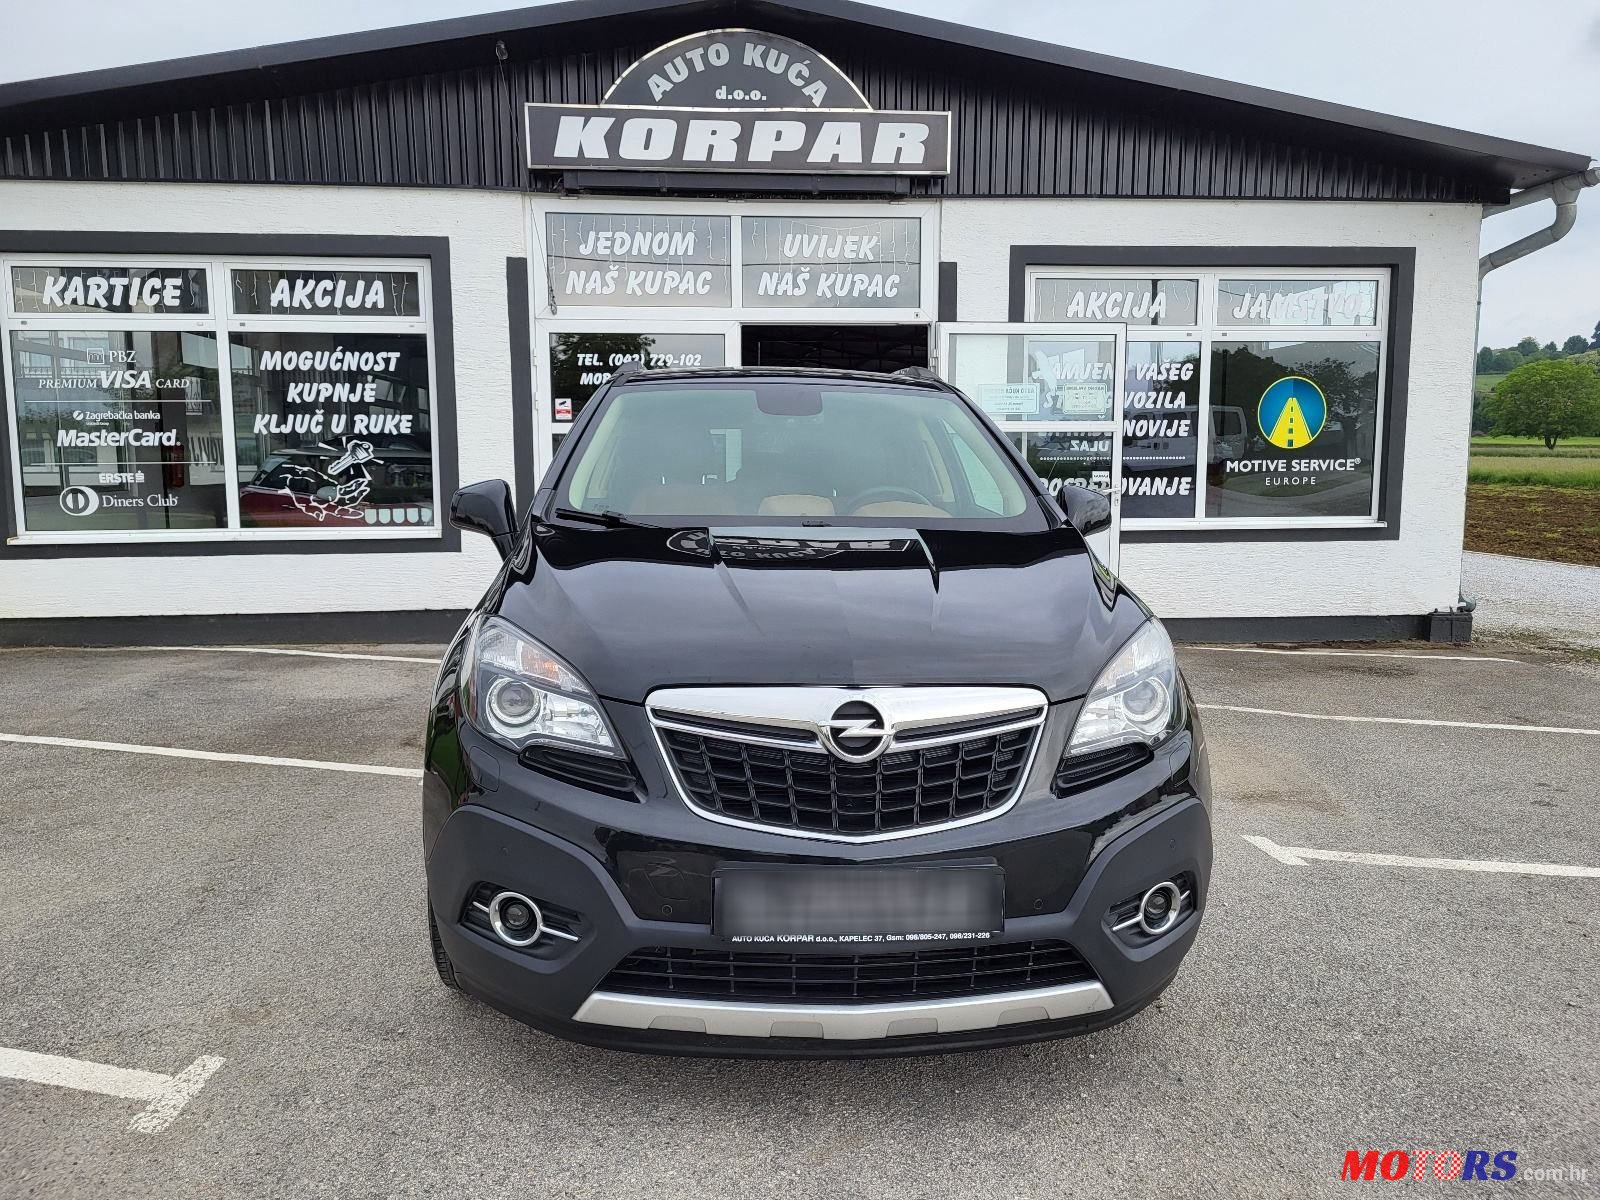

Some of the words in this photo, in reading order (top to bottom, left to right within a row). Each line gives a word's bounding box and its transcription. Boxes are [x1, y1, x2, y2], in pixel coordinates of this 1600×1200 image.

[646, 42, 730, 102] AUTO
[743, 42, 829, 107] KUĆA
[715, 86, 767, 101] d.o.o.
[553, 116, 930, 164] KORPAR
[579, 231, 696, 257] JEDNOM
[783, 233, 878, 262] UVIJEK
[565, 265, 619, 296] NAŠ
[625, 270, 713, 296] KUPAC
[758, 267, 812, 298] NAŠ
[816, 272, 900, 299] KUPAC
[43, 276, 182, 308] KARTICE
[270, 278, 385, 309] AKCIJA
[1066, 291, 1167, 319] AKCIJA
[109, 350, 136, 362] PBZ
[260, 346, 400, 372] MOGUĆNOST
[577, 354, 603, 366] TEL.
[649, 354, 702, 366] 729-102
[38, 379, 97, 389] PREMIUM
[99, 370, 151, 388] VISA
[155, 378, 190, 388] CARD
[1136, 359, 1194, 381] VAŠEG
[287, 383, 377, 404] KUPNJE
[1123, 391, 1186, 409] VOZILA
[85, 410, 133, 421] Zagrebačka
[134, 410, 160, 420] banka
[254, 409, 324, 435] KLJUČ
[332, 414, 346, 434] U
[353, 414, 413, 435] RUKE
[1122, 420, 1190, 437] NOVIJE
[1226, 459, 1287, 472] MOTIVE
[98, 472, 135, 483] ERSTE
[1265, 476, 1316, 486] EUROPE
[102, 494, 144, 507] Diners
[731, 935, 753, 943] AUTO
[776, 934, 814, 943] KORPAR
